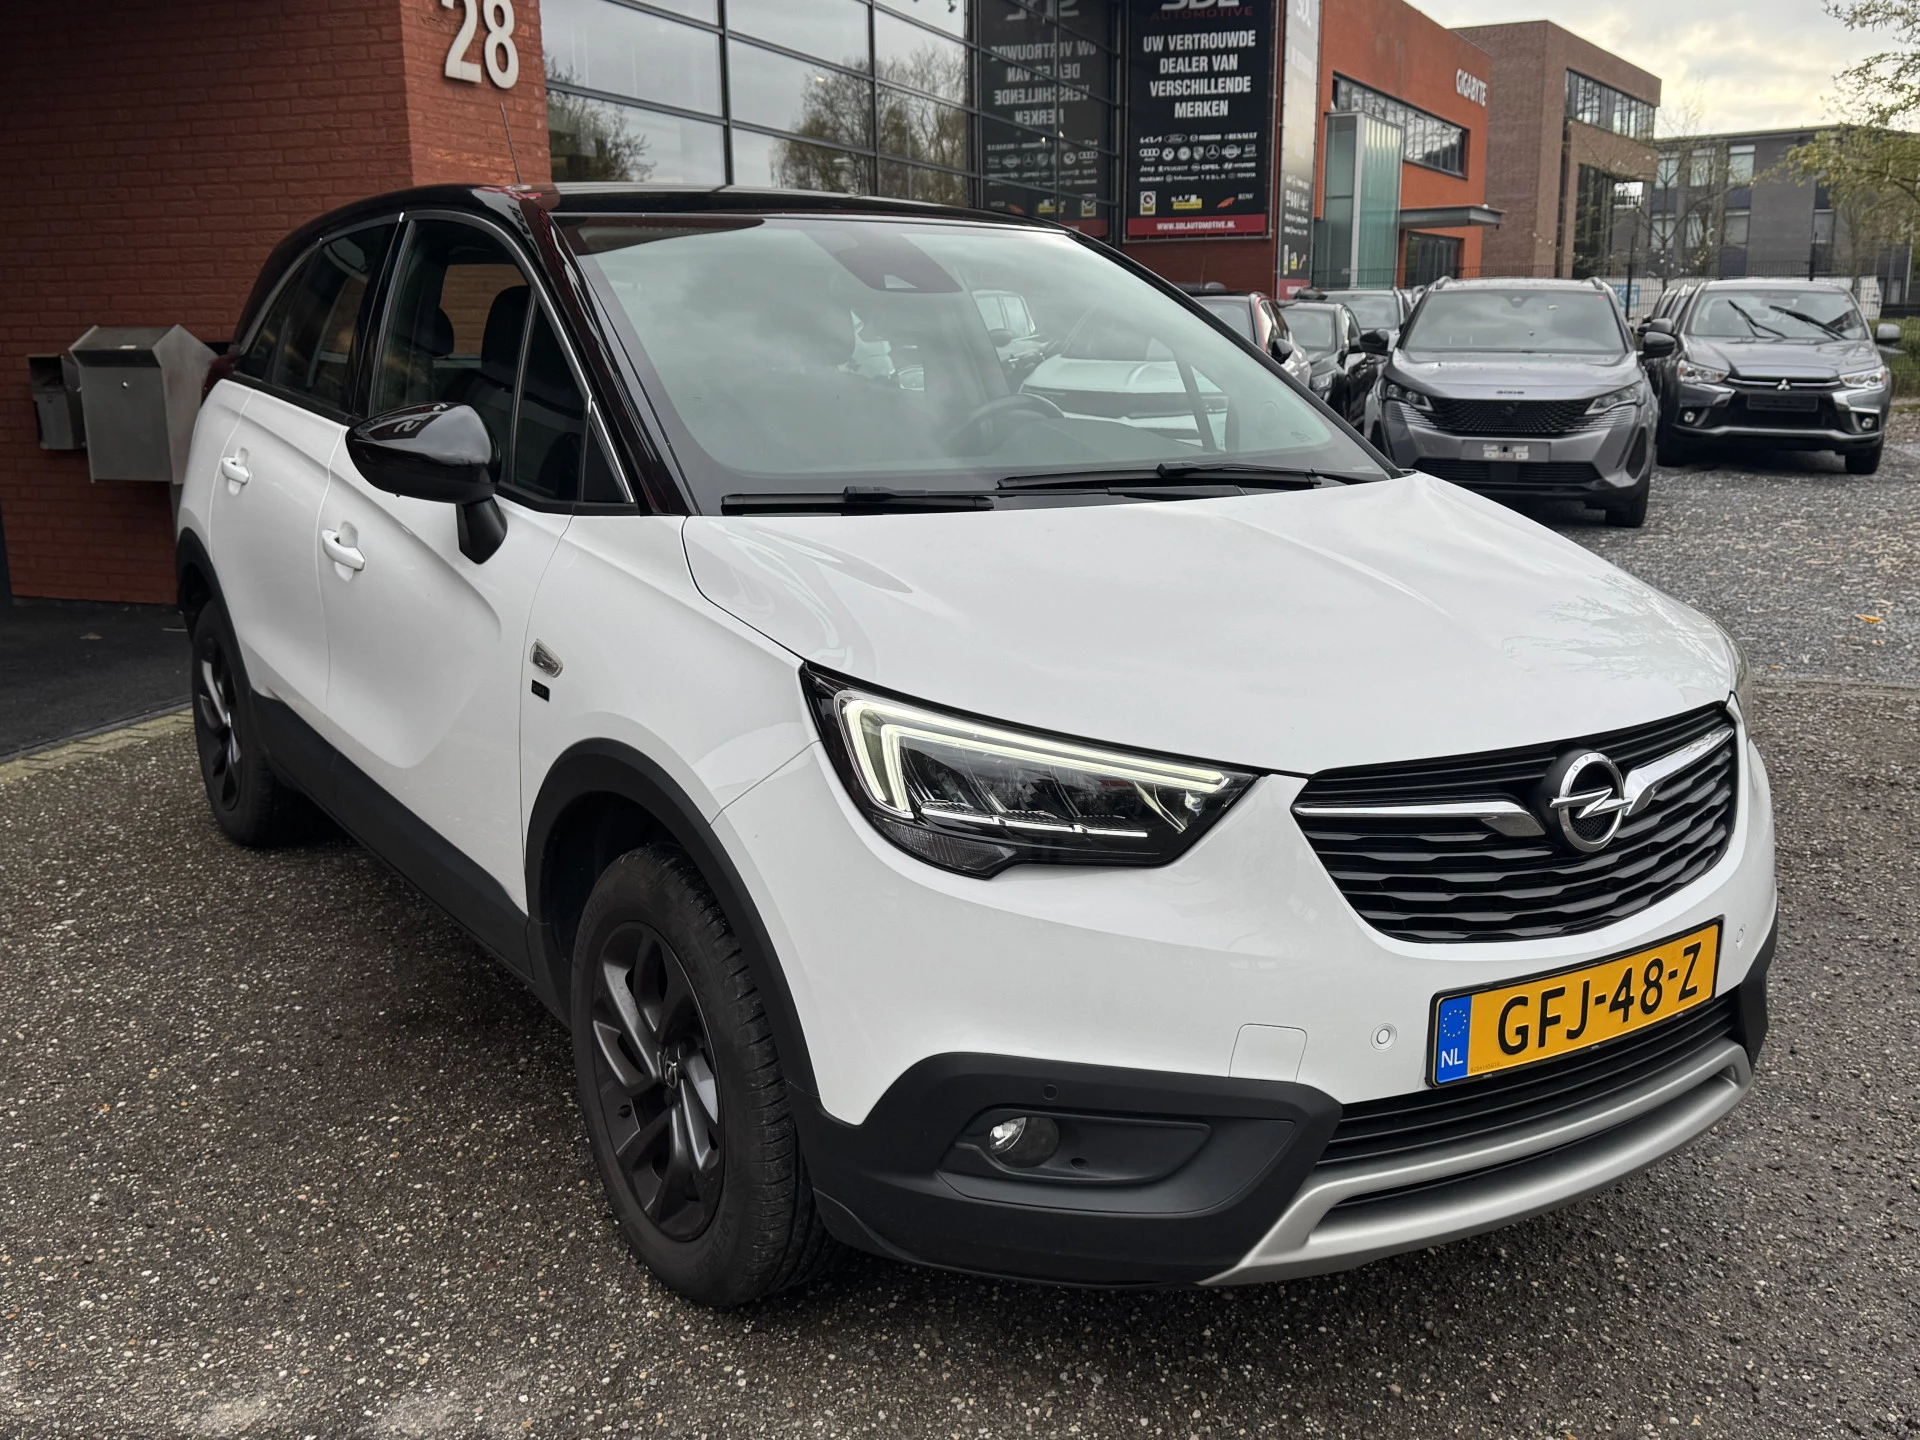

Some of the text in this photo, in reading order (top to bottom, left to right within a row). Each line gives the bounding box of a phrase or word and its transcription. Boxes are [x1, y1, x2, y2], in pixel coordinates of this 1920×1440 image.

[1150, 6, 1254, 20] AUTOMOTIVE
[441, 0, 519, 89] 28
[1143, 30, 1256, 53] UW VERTROUWDE
[1159, 54, 1239, 74] DEALER VAN
[1149, 76, 1252, 97] VERSCHILLENDE
[1456, 68, 1487, 107] GIGABYTE
[1174, 100, 1229, 118] MERKEN
[1497, 941, 1702, 1056] GFJ-48-Z
[1440, 1048, 1464, 1068] NL
